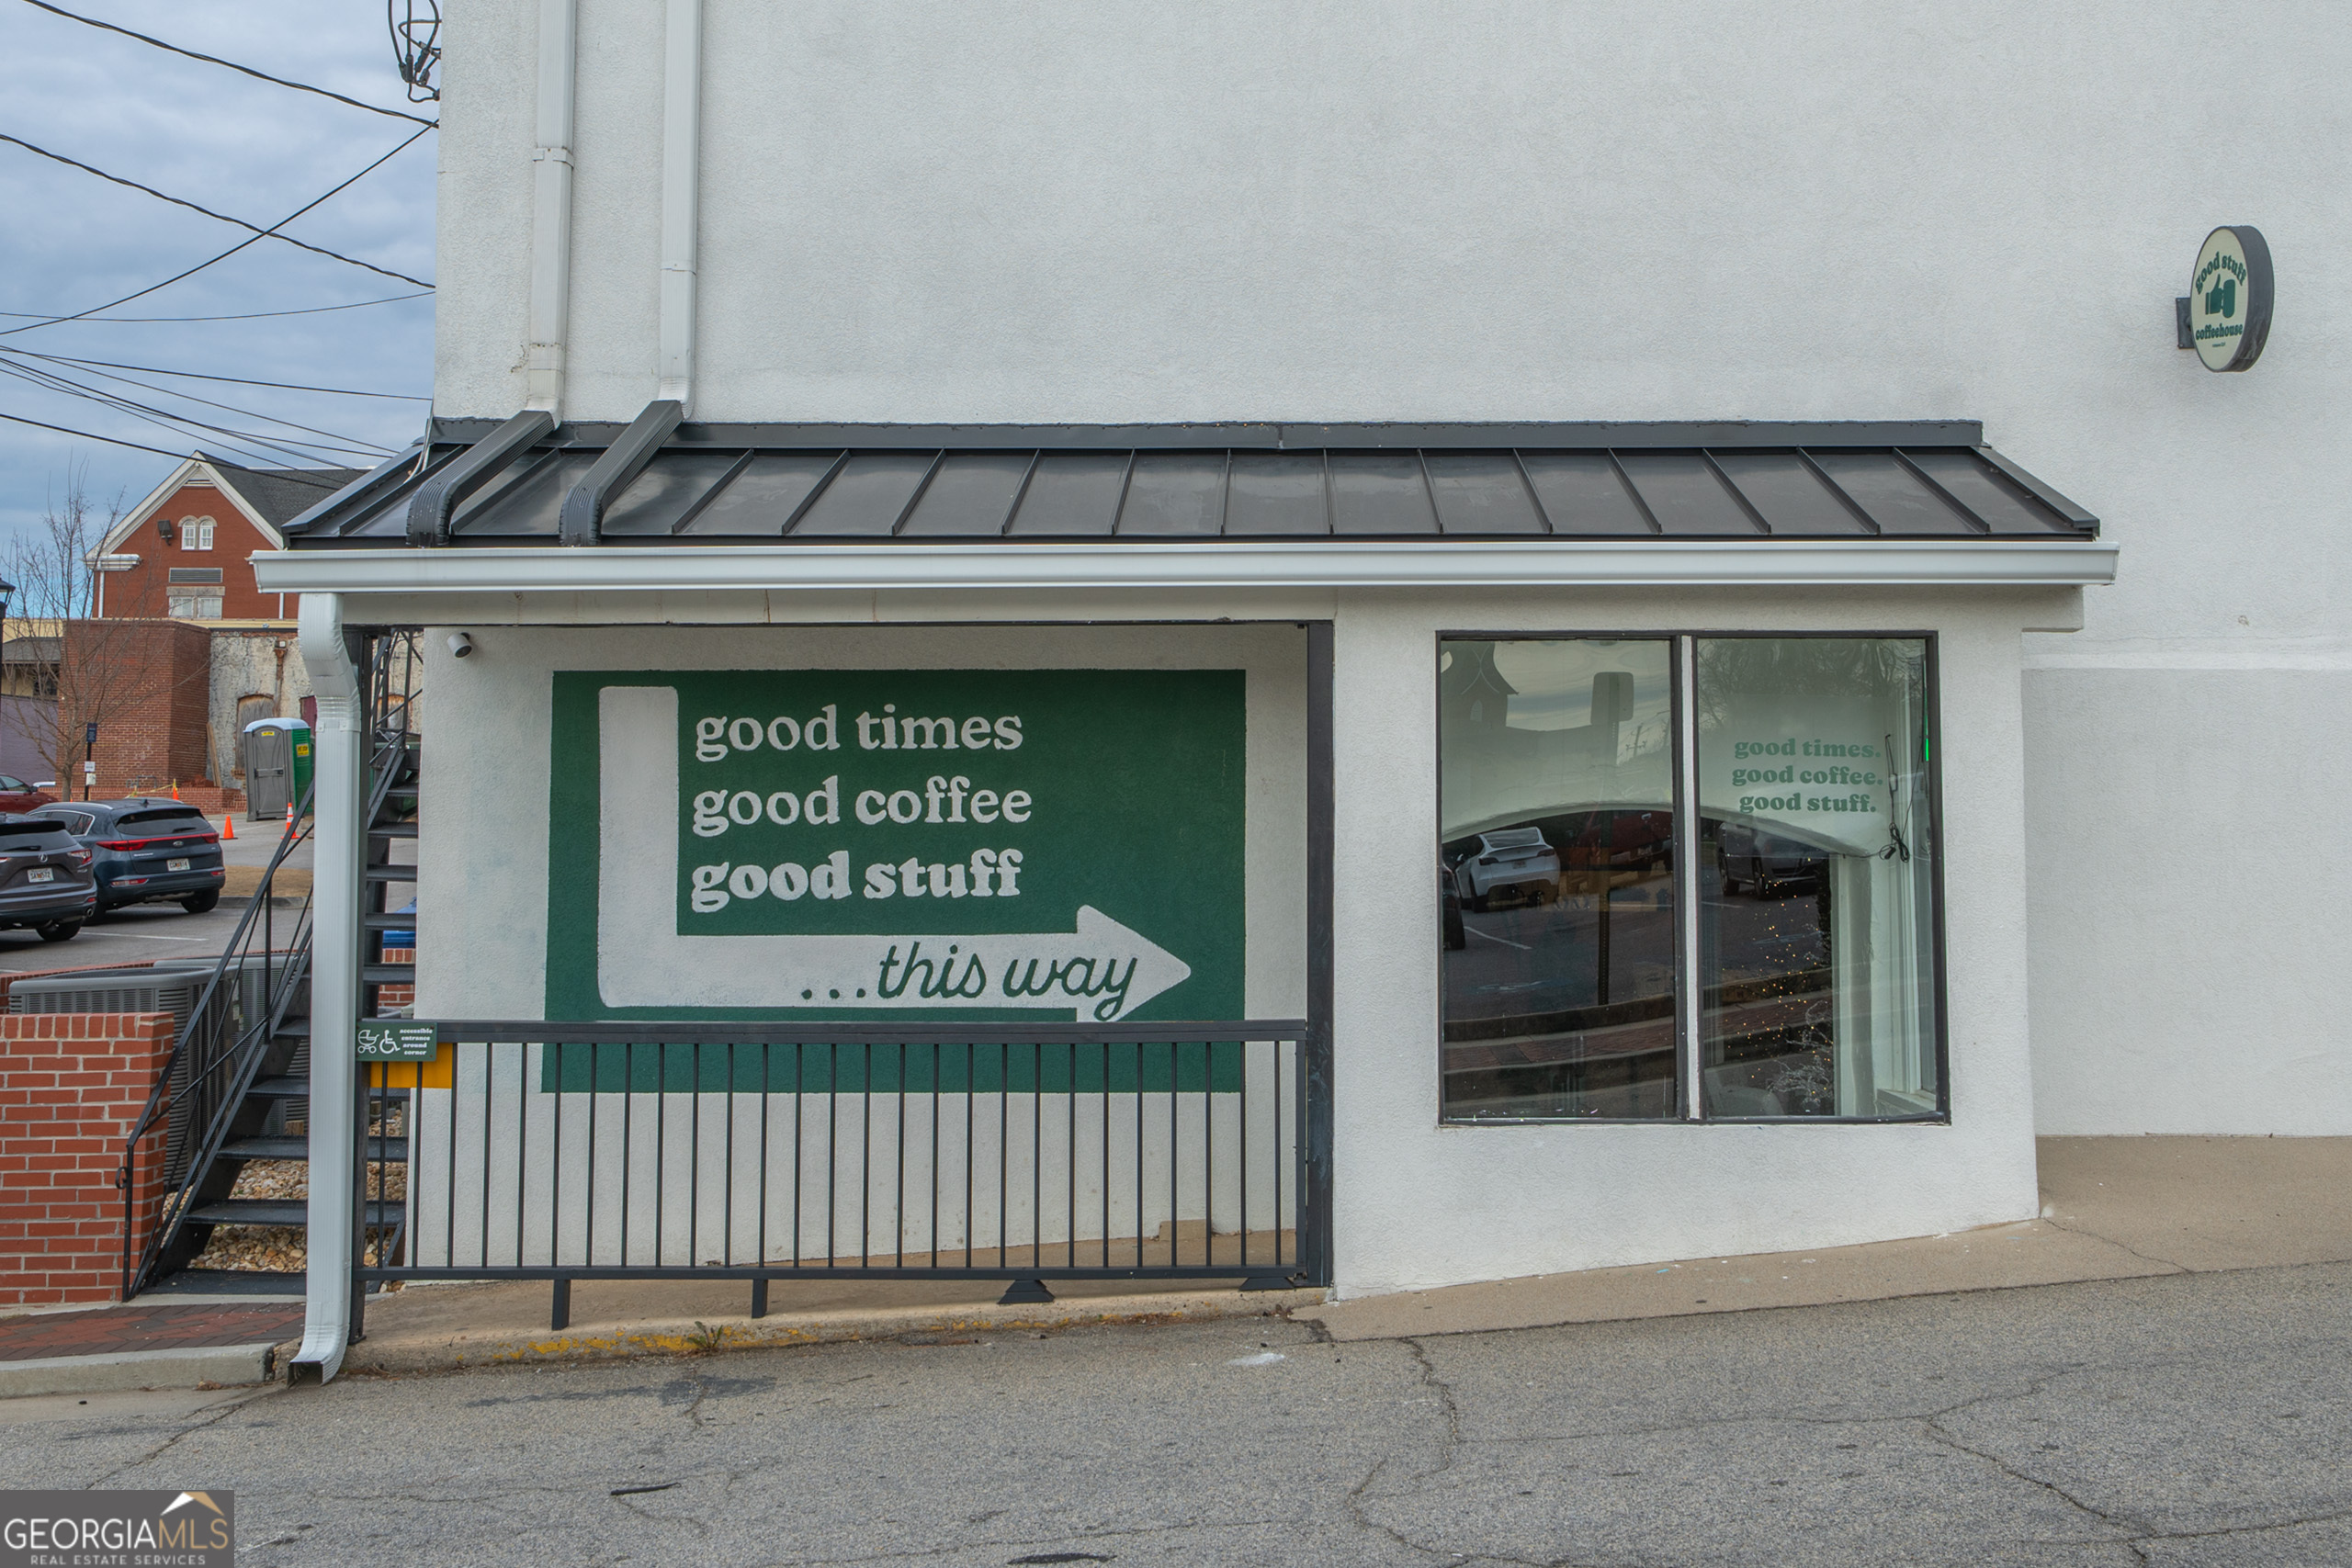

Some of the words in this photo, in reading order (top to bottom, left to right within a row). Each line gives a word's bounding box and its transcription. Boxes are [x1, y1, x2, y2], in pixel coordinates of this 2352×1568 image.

[2195, 251, 2220, 295] good
[2222, 255, 2246, 286] stuff
[2196, 323, 2243, 340] coffeehouse
[695, 705, 840, 761] good
[856, 705, 1023, 751] times
[1735, 738, 1796, 759] good
[1802, 739, 1881, 758] times.
[1732, 765, 1793, 786] good
[1799, 766, 1883, 785] coffee.
[693, 776, 840, 837] good
[855, 776, 1032, 825] coffee
[1739, 792, 1801, 814] good
[1807, 794, 1876, 812] stuff.
[691, 851, 852, 912] good
[864, 849, 1023, 899] stuff
[1002, 957, 1138, 1021] way
